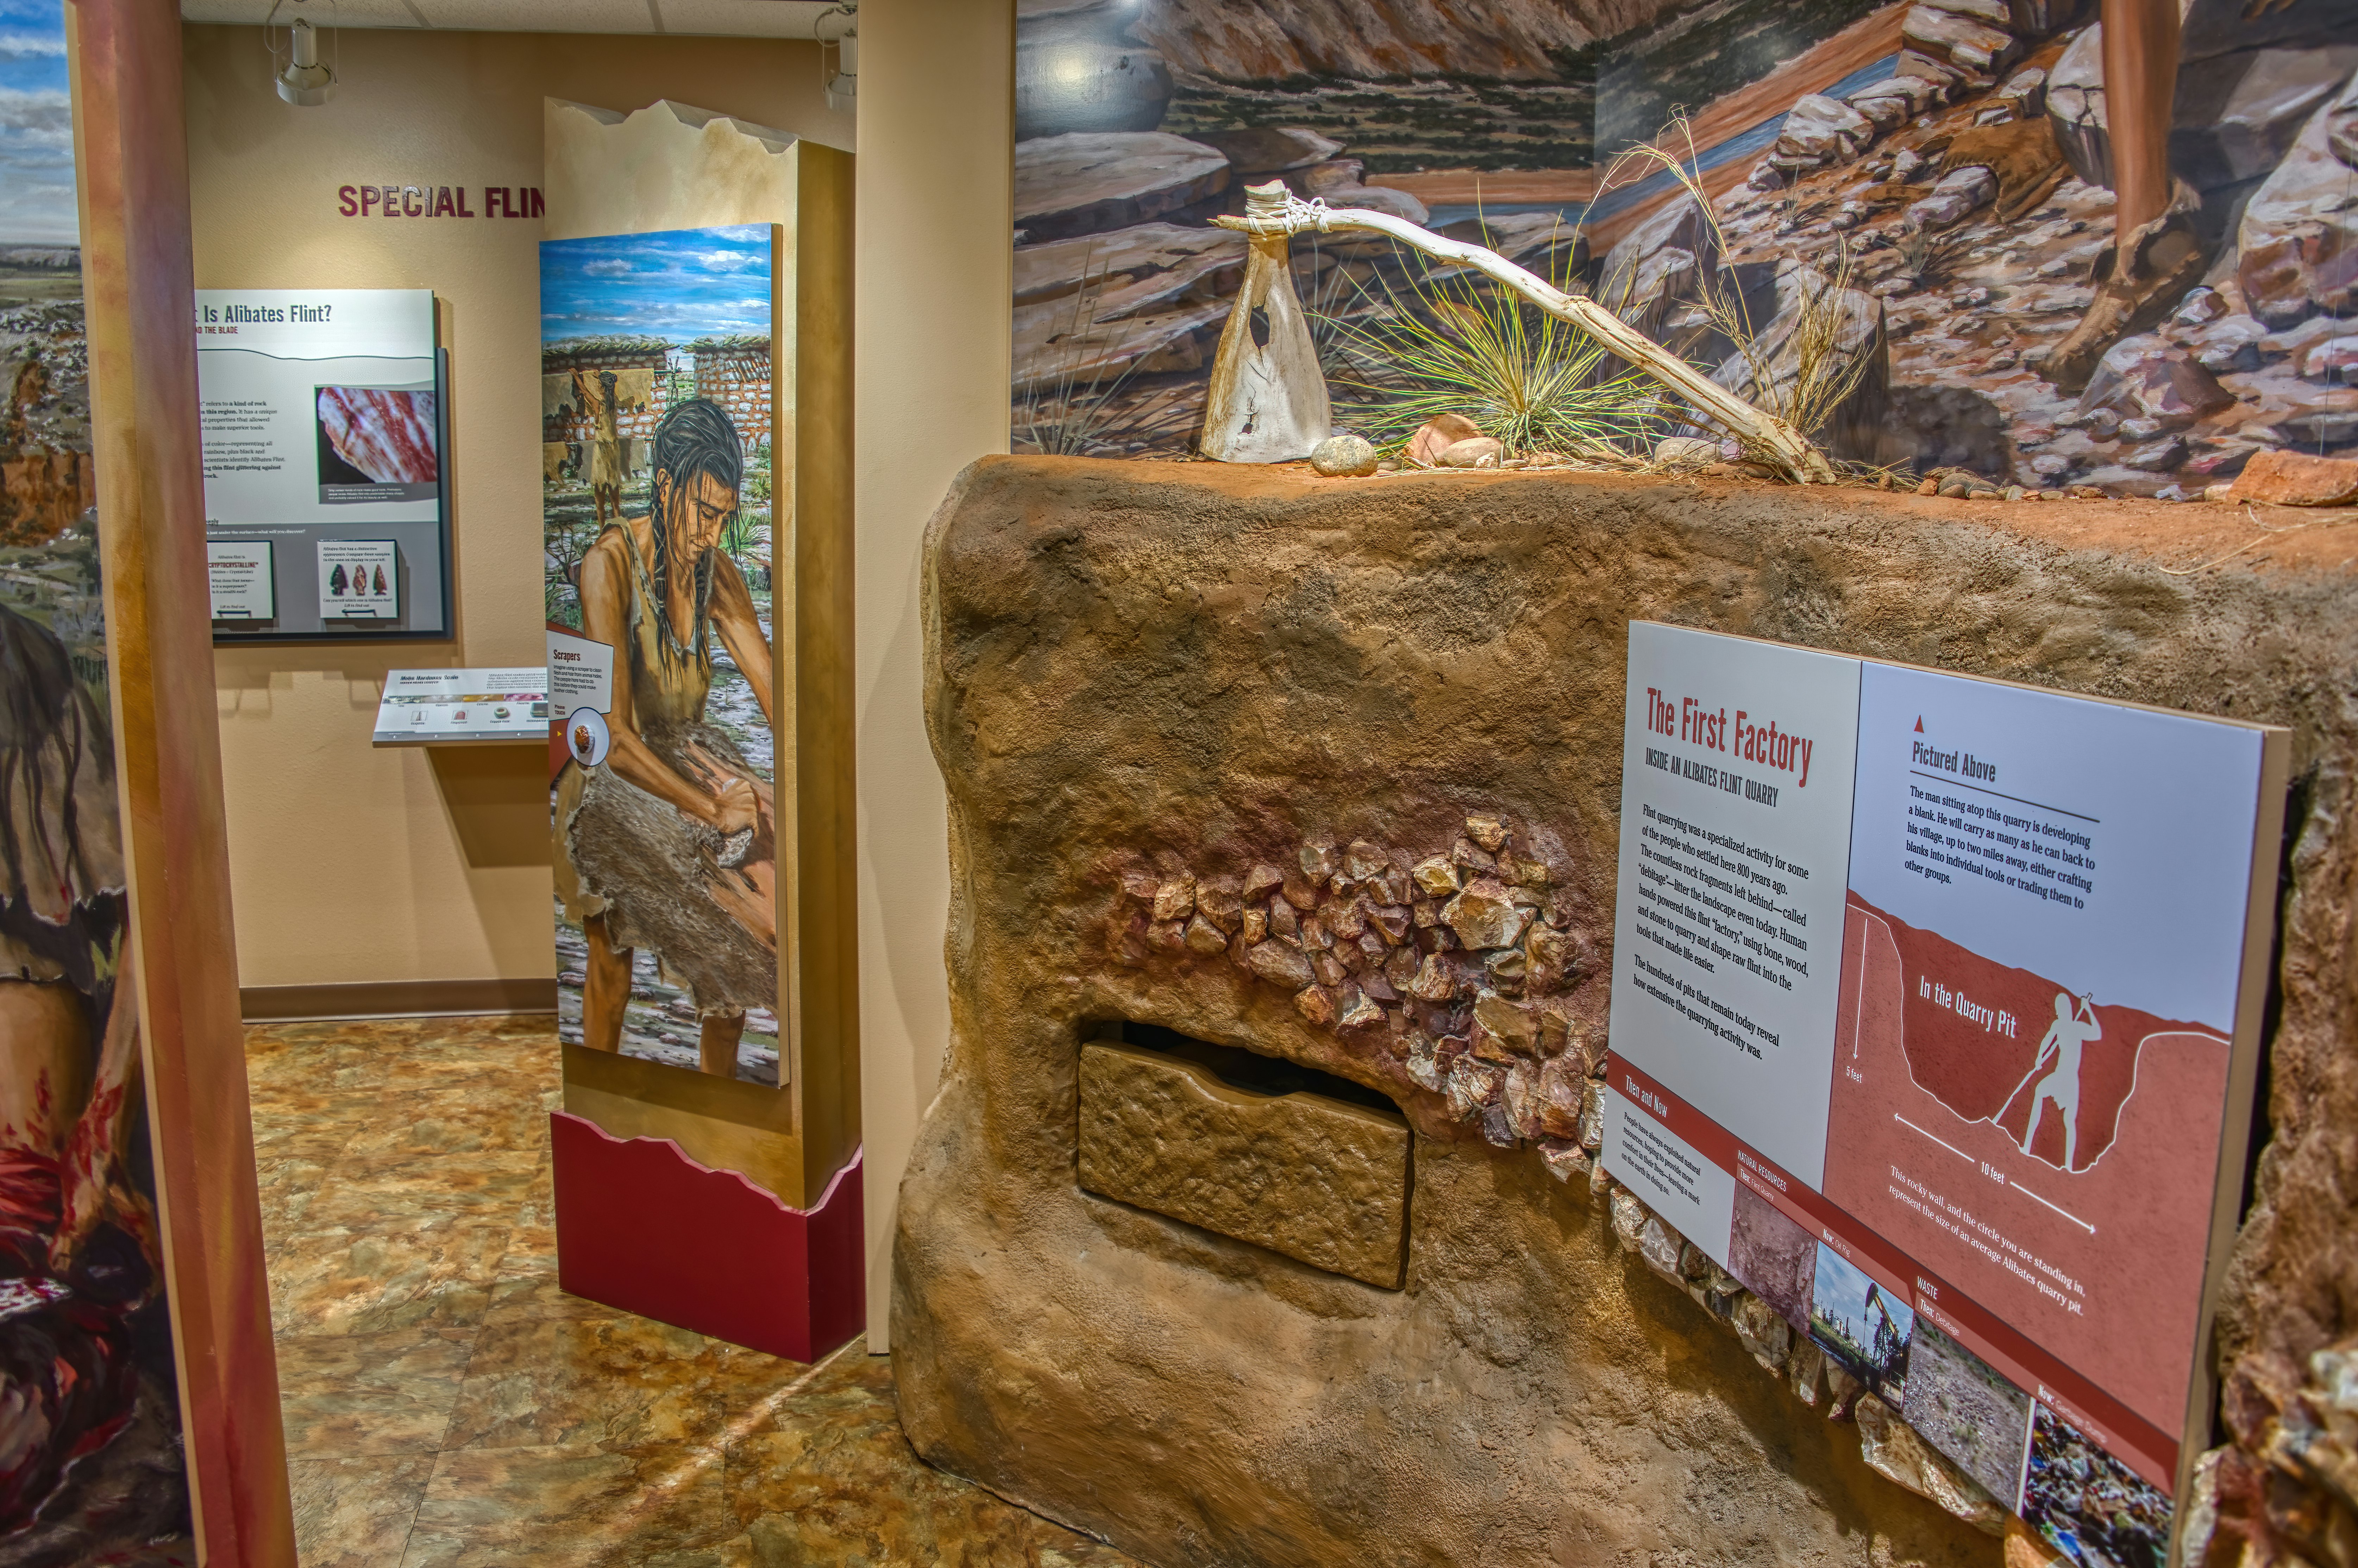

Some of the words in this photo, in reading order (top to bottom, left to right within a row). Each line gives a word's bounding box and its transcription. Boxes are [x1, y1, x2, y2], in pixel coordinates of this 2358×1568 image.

[338, 186, 474, 218] SPECIAL
[204, 305, 218, 322] Is
[225, 305, 283, 322] Alibates
[290, 305, 331, 322] Flint?
[553, 649, 581, 663] Scrapers
[1648, 688, 1674, 736] The
[1682, 697, 1726, 752] First
[1735, 710, 1813, 788] Factory
[1913, 741, 1958, 773] Pictured
[1962, 754, 1995, 782] Above
[1646, 747, 1668, 771] INSIDE
[1671, 756, 1681, 775] AN
[1683, 760, 1717, 787] ALIBATES
[1720, 771, 1743, 795] FLINT
[1745, 779, 1779, 807] QUARRY
[1643, 804, 1656, 819] Flint
[1657, 813, 1687, 834] quarrying
[1688, 824, 1700, 836] was
[1702, 830, 1706, 839] a
[1707, 832, 1745, 854] specialized
[1746, 847, 1774, 867] activity
[1775, 855, 1786, 870] for
[1788, 864, 1808, 879] some
[1910, 785, 1923, 799] The
[1925, 793, 1940, 804] man
[1942, 796, 1965, 813] sitting
[1967, 804, 1984, 819] atop
[1986, 808, 2001, 821] this
[2003, 815, 2031, 832] quarry
[2033, 820, 2040, 832] is
[2042, 823, 2090, 850] developing
[1641, 843, 1652, 858] The
[1653, 852, 1682, 871] countless
[1683, 865, 1698, 879] rock
[1699, 868, 1732, 893] fragments
[1735, 884, 1746, 900] left
[1905, 860, 1924, 873] other
[1925, 868, 1951, 884] groups.
[1907, 822, 1918, 834] his
[1920, 827, 1944, 845] village,
[1946, 837, 1955, 849] up
[1958, 839, 1965, 849] to
[1967, 842, 1981, 855] two
[1983, 848, 2005, 862] miles
[2006, 856, 2028, 872] away,
[2031, 863, 2056, 878] either
[2058, 872, 2092, 893] crafting
[1639, 883, 1656, 901] hands
[1657, 895, 1683, 914] powered
[1685, 906, 1696, 920] this
[1697, 911, 1710, 927] flint
[1743, 936, 1762, 955] using
[1764, 943, 1783, 966] bone,
[1785, 957, 1808, 978] wood,
[1690, 888, 1701, 901] the
[1702, 892, 1736, 918] landscape
[1738, 911, 1754, 926] even
[1756, 917, 1777, 939] today.
[1780, 927, 1807, 951] Human
[1635, 954, 1645, 970] The
[1646, 961, 1674, 986] hundreds
[1676, 980, 1682, 991] of
[1683, 984, 1695, 998] pits
[1697, 990, 1710, 1006] that
[1711, 1001, 1733, 1021] remain
[1735, 1012, 1756, 1034] today
[1757, 1027, 1779, 1047] reveal
[1920, 976, 1930, 999] In
[1935, 983, 1951, 1008] the
[1956, 992, 1994, 1032] Quarry
[1998, 1010, 2016, 1038] Pit
[1626, 1075, 1639, 1098] Then
[1642, 1091, 1652, 1107] and
[1654, 1095, 1667, 1118] Now
[1846, 1066, 1850, 1076] 5
[1851, 1068, 1862, 1083] feet
[1624, 1112, 1638, 1128] People
[1638, 1123, 1649, 1136] have
[1649, 1132, 1663, 1147] always
[1664, 1143, 1684, 1163] exploited
[1685, 1159, 1700, 1176] natural
[1738, 1150, 1757, 1172] NATURAL
[1758, 1164, 1786, 1192] RESOURCES
[1981, 1161, 1989, 1175] 10
[1991, 1167, 2004, 1185] feet
[1823, 1229, 1834, 1244] Now:
[1889, 1185, 1921, 1211] represent
[1923, 1205, 1934, 1219] the
[1935, 1215, 1949, 1229] size
[1951, 1225, 1959, 1235] of
[1960, 1231, 1969, 1242] an
[1970, 1238, 2001, 1262] average
[2002, 1256, 2035, 1285] Alibates
[2037, 1281, 2067, 1306] quarry
[2068, 1300, 2083, 1316] pit.
[1892, 1166, 1906, 1183] This
[1907, 1179, 1927, 1197] rocky
[1929, 1192, 1945, 1209] wall,
[1947, 1204, 1961, 1218] and
[1963, 1212, 1976, 1227] the
[1977, 1223, 1999, 1242] circle
[2001, 1237, 2017, 1253] you
[2019, 1249, 2032, 1262] are
[2034, 1258, 2072, 1290] standing
[2074, 1280, 2086, 1298] in,
[1918, 1276, 1938, 1299] WASTE
